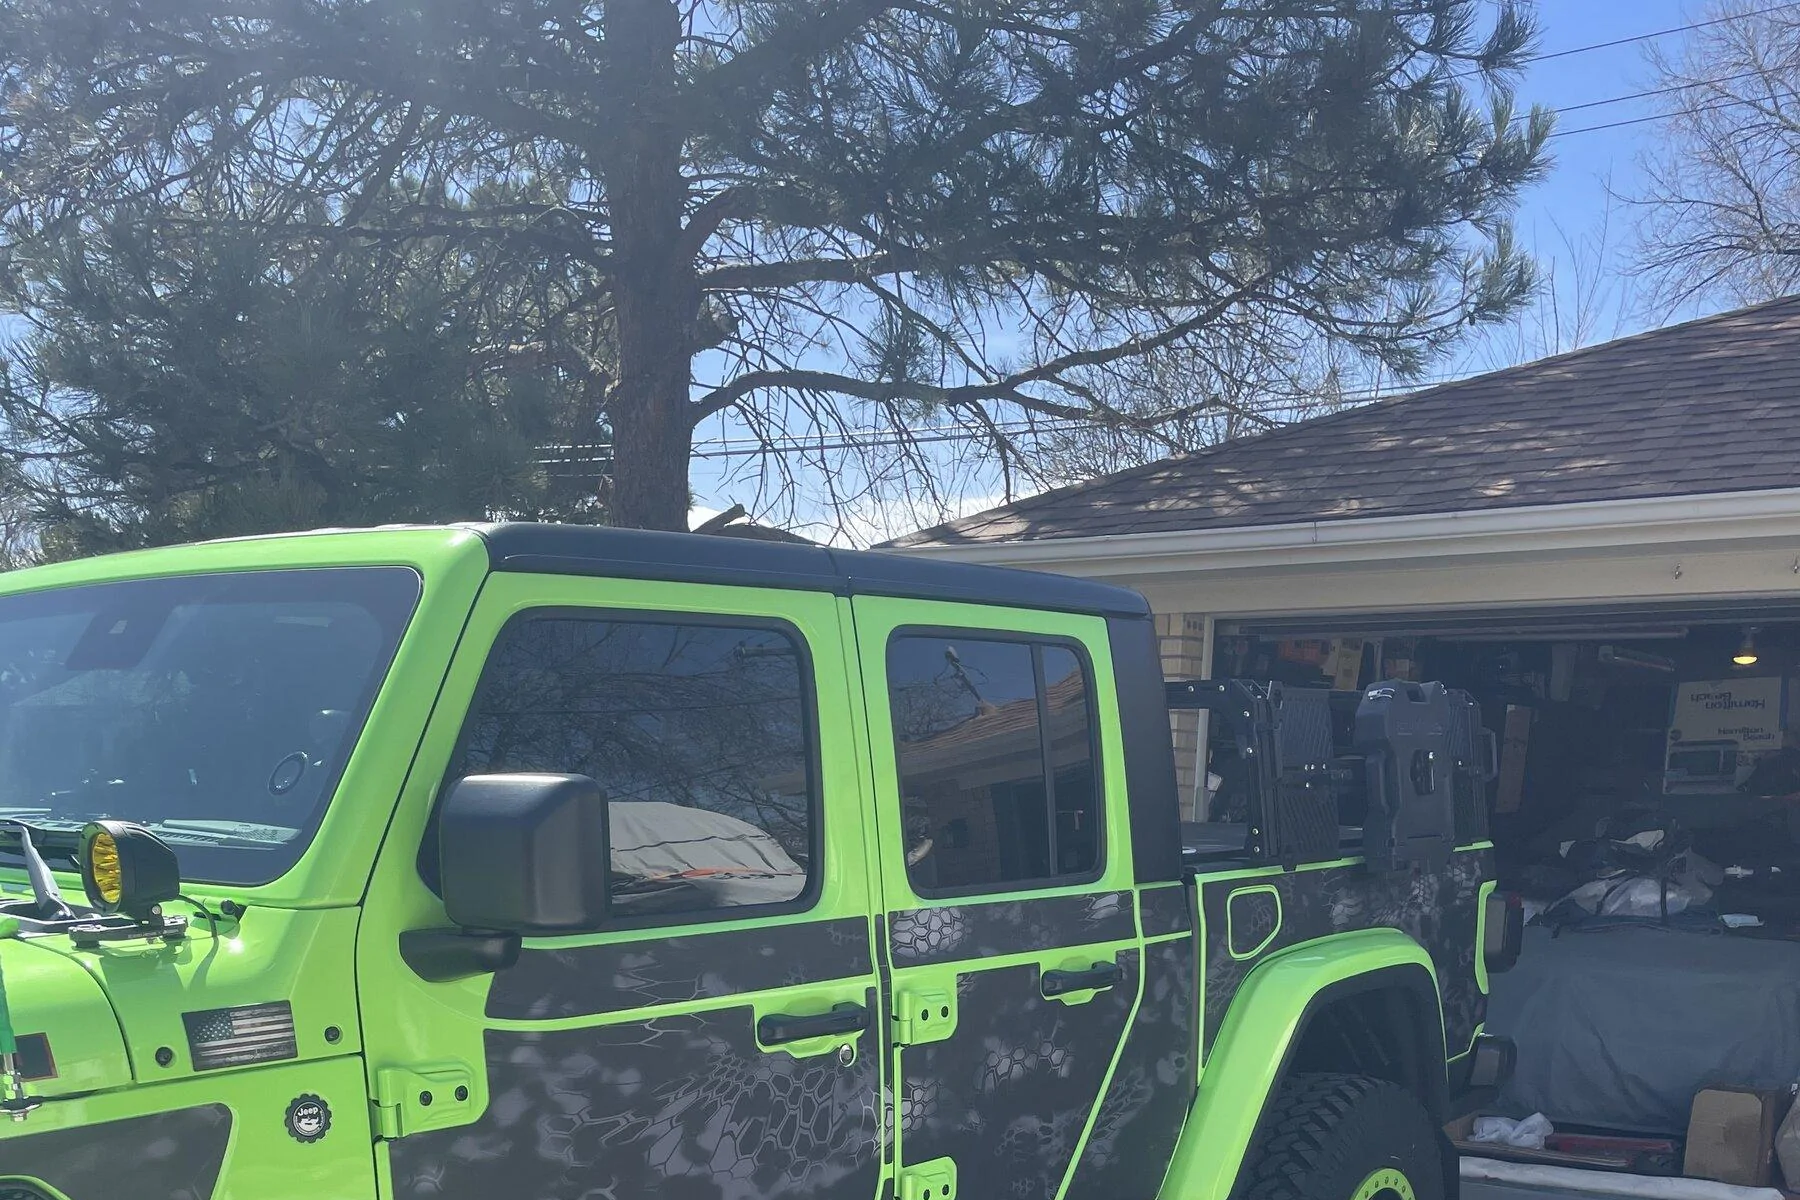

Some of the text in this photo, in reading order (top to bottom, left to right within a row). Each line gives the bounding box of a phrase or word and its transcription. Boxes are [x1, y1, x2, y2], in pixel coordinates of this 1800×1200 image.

[1690, 692, 1731, 702] Beach
[1705, 698, 1765, 710] Hamilton
[1718, 726, 1763, 736] Hamilton
[1743, 732, 1775, 741] Beach
[297, 1106, 319, 1117] Jeep
